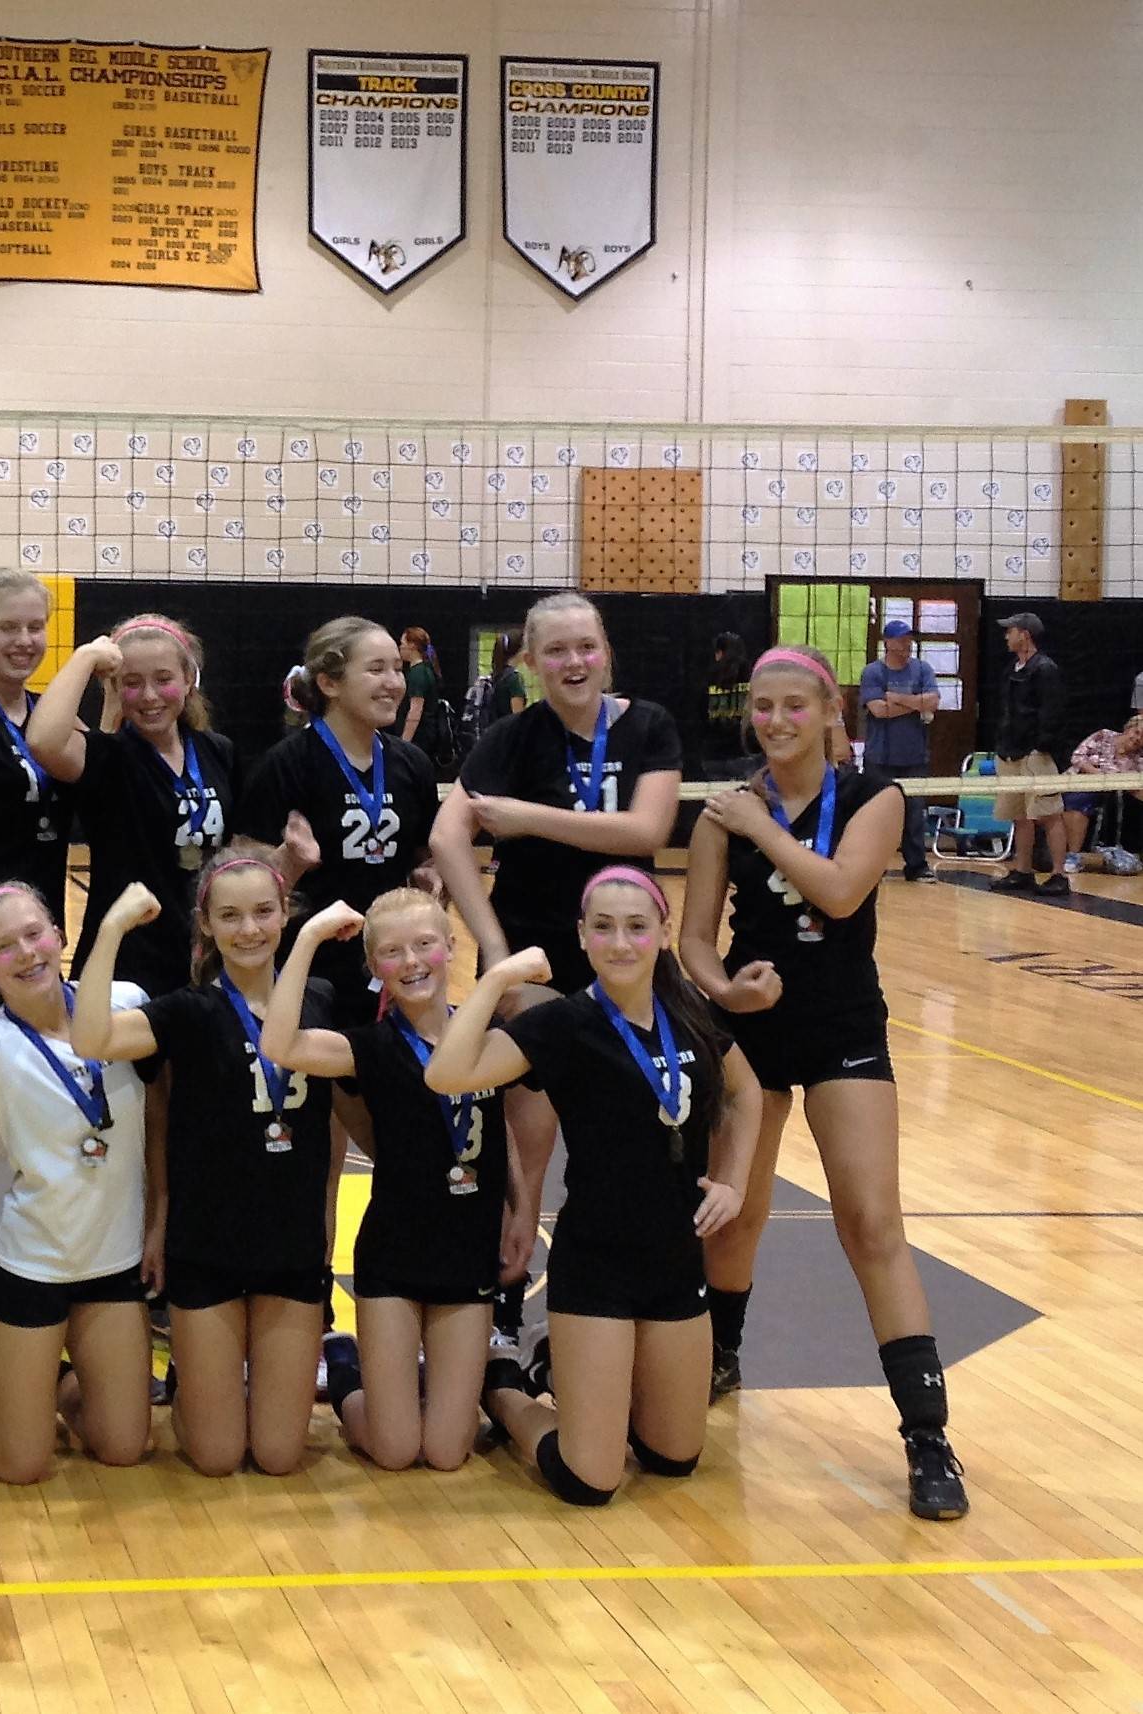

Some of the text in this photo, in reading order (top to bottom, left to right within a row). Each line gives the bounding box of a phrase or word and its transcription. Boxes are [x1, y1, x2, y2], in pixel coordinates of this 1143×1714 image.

[109, 51, 158, 67] MIDDLE
[167, 55, 220, 72] SCHOOL
[70, 67, 227, 90] CHAMPIONSHIPS
[358, 76, 418, 92] TRACK
[22, 84, 66, 97] SOCCER
[125, 87, 240, 106] BOYS BASKETBALL
[510, 80, 649, 101] CROSS COUNTRY
[316, 94, 459, 109] CHAMPIONS
[509, 100, 650, 116] CHAMPIONS
[319, 110, 455, 124] 2003 2004 2005 2006
[512, 116, 646, 131] 2002 2003 2005 2006
[24, 123, 67, 135] SOCCER
[123, 125, 238, 141] GIRLS BASKETBALL
[319, 123, 452, 137] 2007 2008 2009 2010
[511, 129, 643, 143] 2007 2008 2009 2010
[319, 136, 418, 149] 2011 2012 2013
[511, 142, 573, 154] 2011 2013
[139, 163, 216, 178] BOYS TRACK
[22, 197, 69, 210] HOCKEY
[137, 203, 170, 215] GIRLS
[177, 205, 214, 217] TRACK
[151, 227, 200, 239] BOYS XC
[332, 236, 443, 246] GIRLS GIRLS
[524, 240, 631, 253] BOYS BOYS
[146, 249, 180, 261] GIRLS
[186, 251, 201, 262] XC
[174, 799, 225, 847] 24
[341, 808, 400, 859] 22
